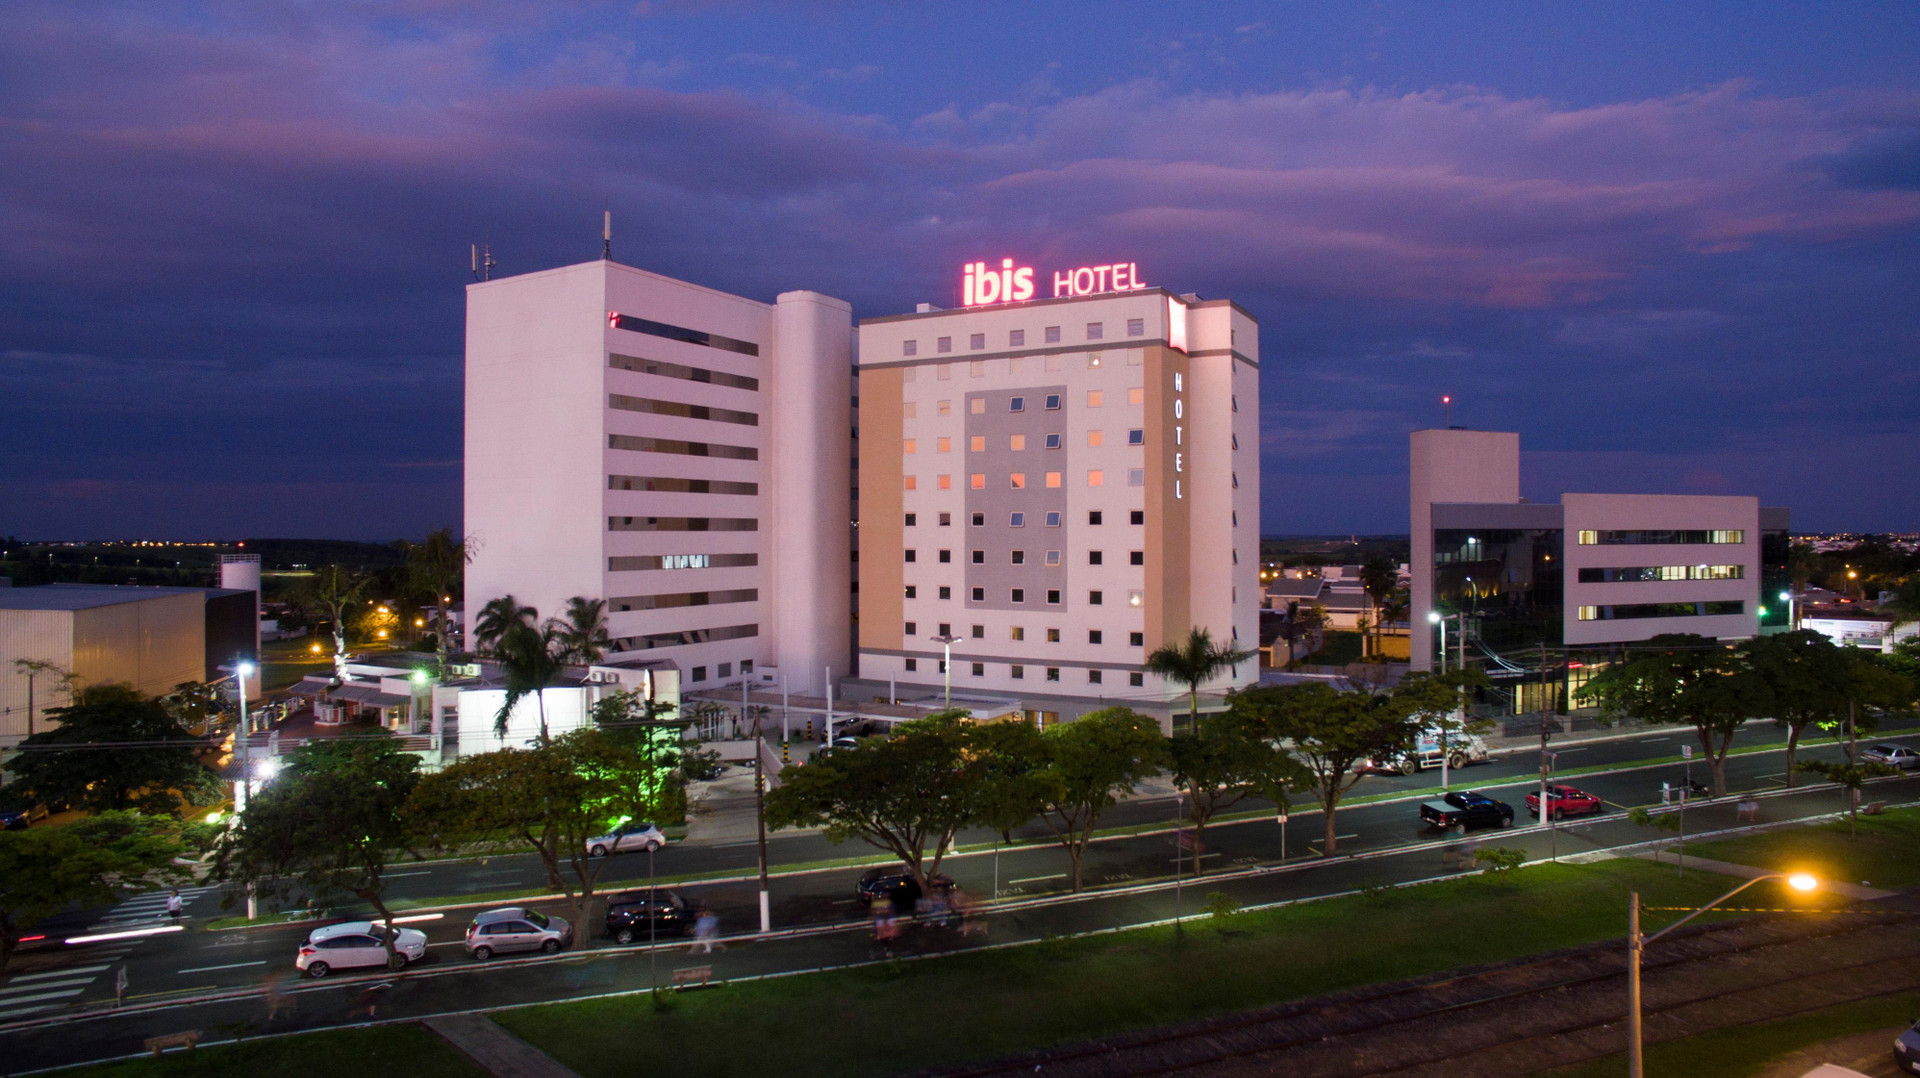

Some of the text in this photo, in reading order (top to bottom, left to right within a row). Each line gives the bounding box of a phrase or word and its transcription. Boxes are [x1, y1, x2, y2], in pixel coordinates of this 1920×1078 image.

[964, 258, 1146, 306] ibis HOTEL
[1174, 372, 1183, 499] HOTEL
